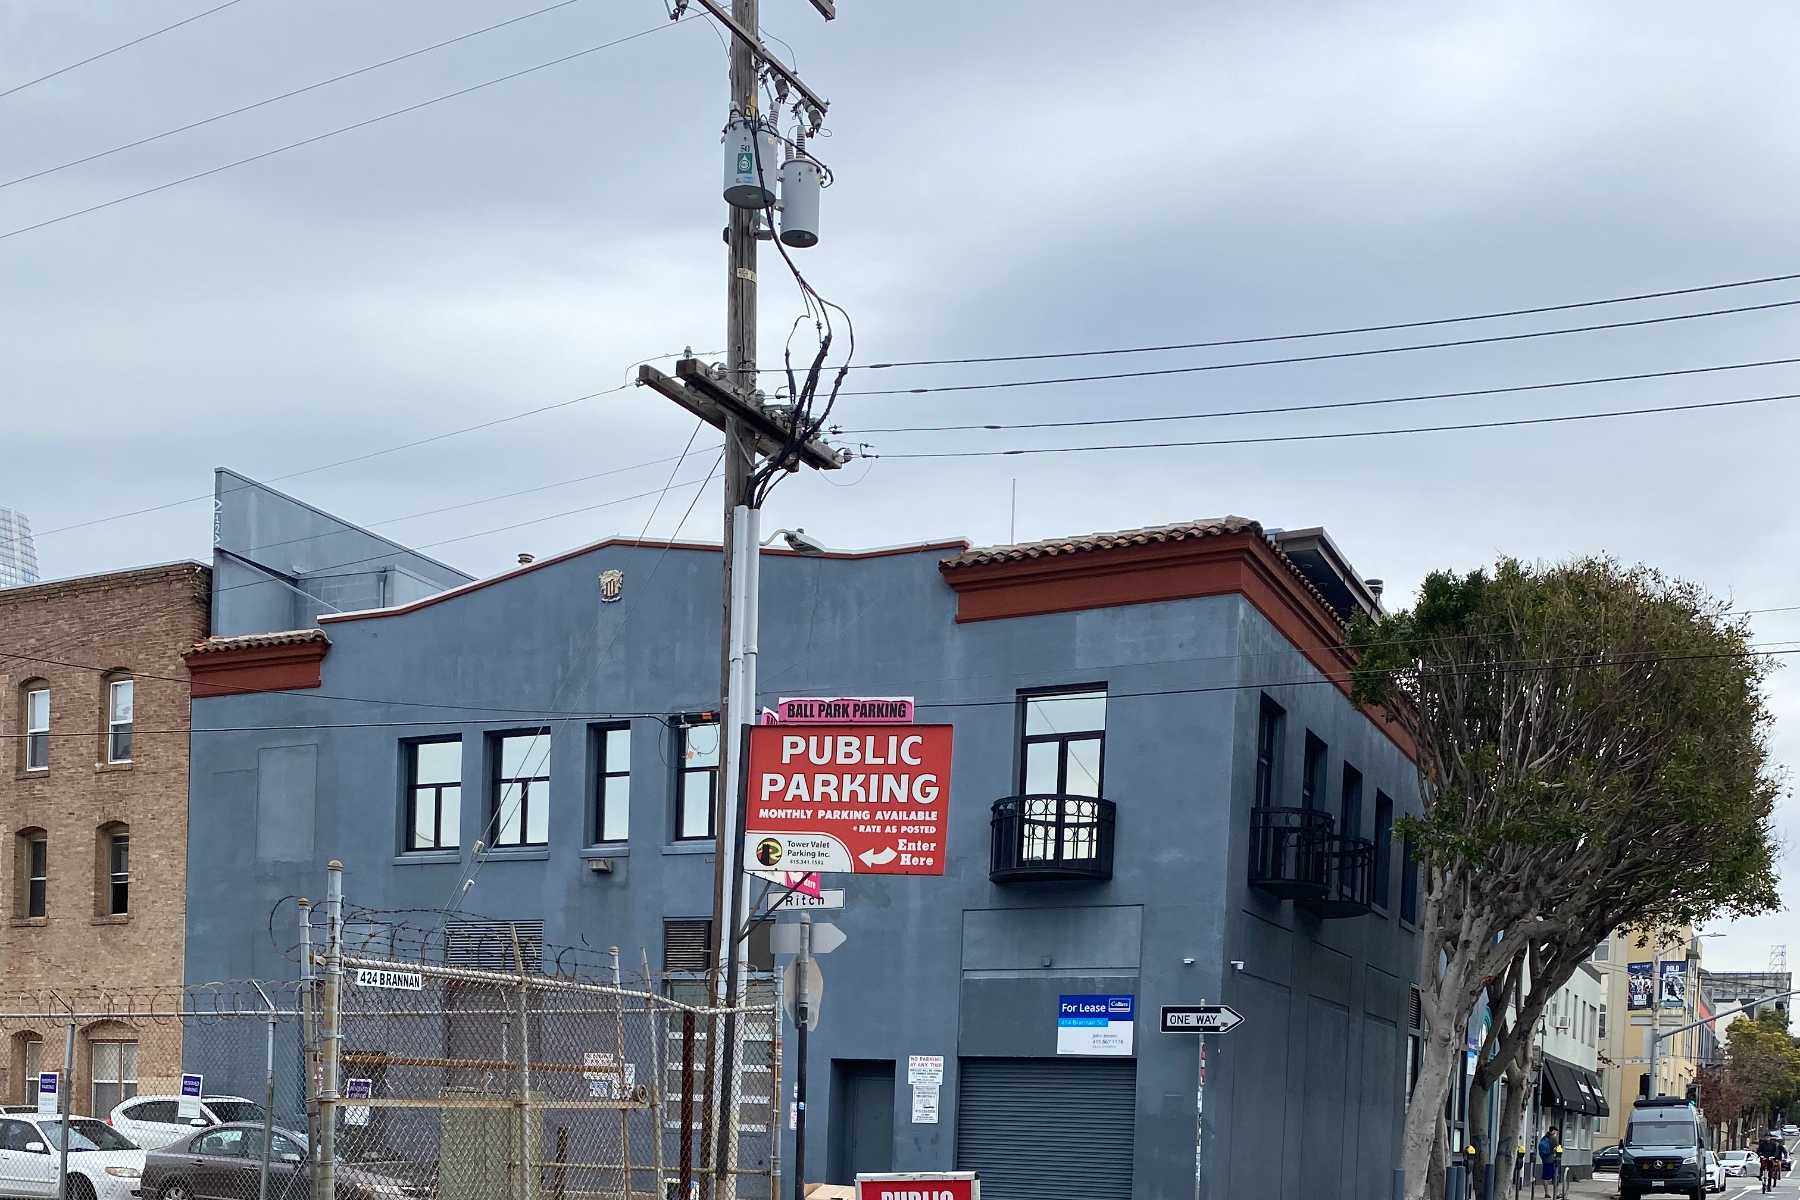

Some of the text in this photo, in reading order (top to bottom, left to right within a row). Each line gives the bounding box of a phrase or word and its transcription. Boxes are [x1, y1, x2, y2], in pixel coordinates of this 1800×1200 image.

[787, 703, 906, 719] BALL PARK PARKING
[781, 735, 923, 766] PUBLIC
[760, 773, 940, 805] PARKING
[758, 808, 938, 821] MONTHLY PARKING AVAILABLE
[885, 825, 898, 833] AS
[900, 825, 937, 834] POSTED
[787, 840, 830, 848] Tower Valet
[896, 838, 937, 852] Enter
[787, 849, 816, 859] Parking
[899, 853, 934, 867] Here
[360, 970, 420, 988] 424 BRANNAN
[1061, 1003, 1106, 1013] For Lease
[1169, 1014, 1191, 1025] ONE
[1196, 1014, 1218, 1025] WAY
